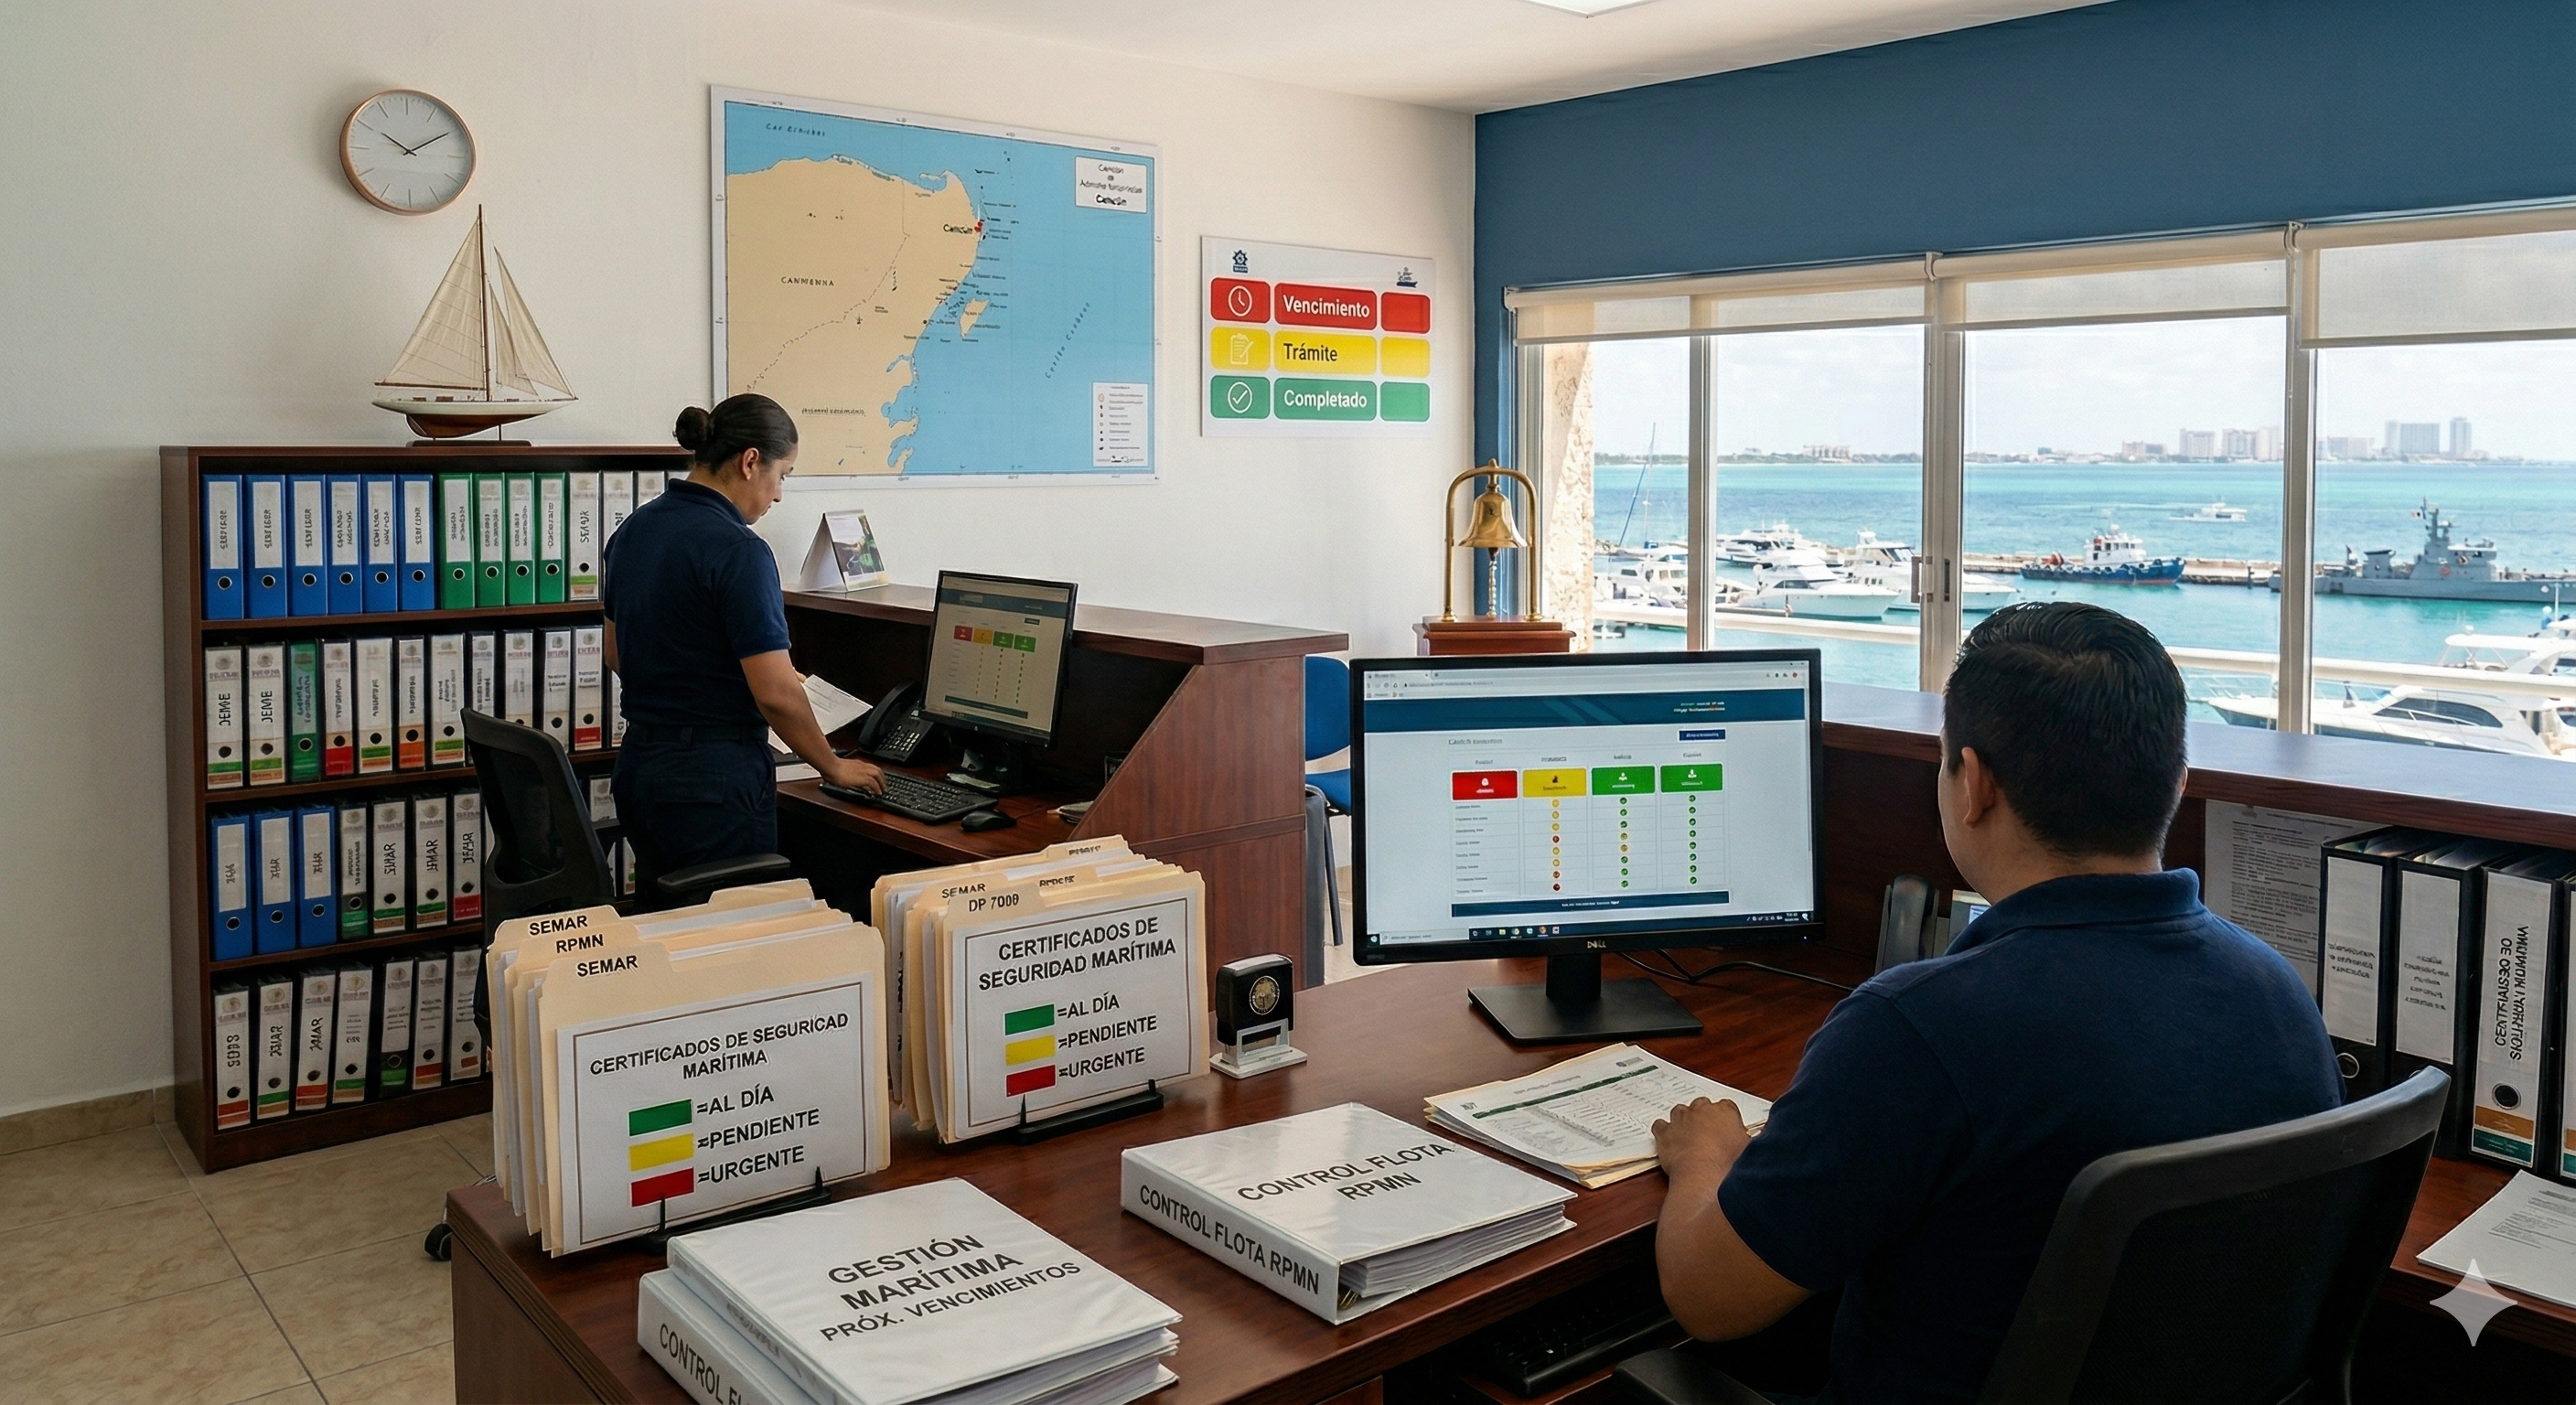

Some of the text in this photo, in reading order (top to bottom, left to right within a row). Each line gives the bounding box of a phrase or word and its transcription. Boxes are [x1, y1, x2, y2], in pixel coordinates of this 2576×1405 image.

[1283, 294, 1370, 318] Vencimiento
[1283, 342, 1338, 362] Trámite
[1283, 389, 1368, 411] Completado
[941, 883, 986, 898] SEMAR
[969, 897, 986, 912] DP
[530, 915, 588, 936] SEMAR
[999, 917, 1158, 960] CERTIFICADOS DE
[555, 934, 604, 953] RPMN
[576, 955, 638, 977] SEMAR
[979, 938, 1176, 991] SEGURIDAD MARÍTIMA
[1092, 991, 1120, 1014] DÍA
[590, 1036, 721, 1075] CERTIFICADOS
[725, 1032, 748, 1049] DE
[682, 1049, 767, 1079] MARÍTIMA
[740, 1083, 775, 1108] DÍA
[1237, 1141, 1454, 1202] CONTROL FLOTA
[1336, 1170, 1422, 1202] RPMN
[1139, 1184, 1320, 1295] CONTROL FLOTA RPMN
[827, 1233, 985, 1285] GESTIÓN
[840, 1252, 1025, 1311] MARÍTIMA
[820, 1309, 906, 1343] PRÓX.
[904, 1261, 1082, 1321] VENCIMIENTOS
[660, 1323, 724, 1405] CONTROL
